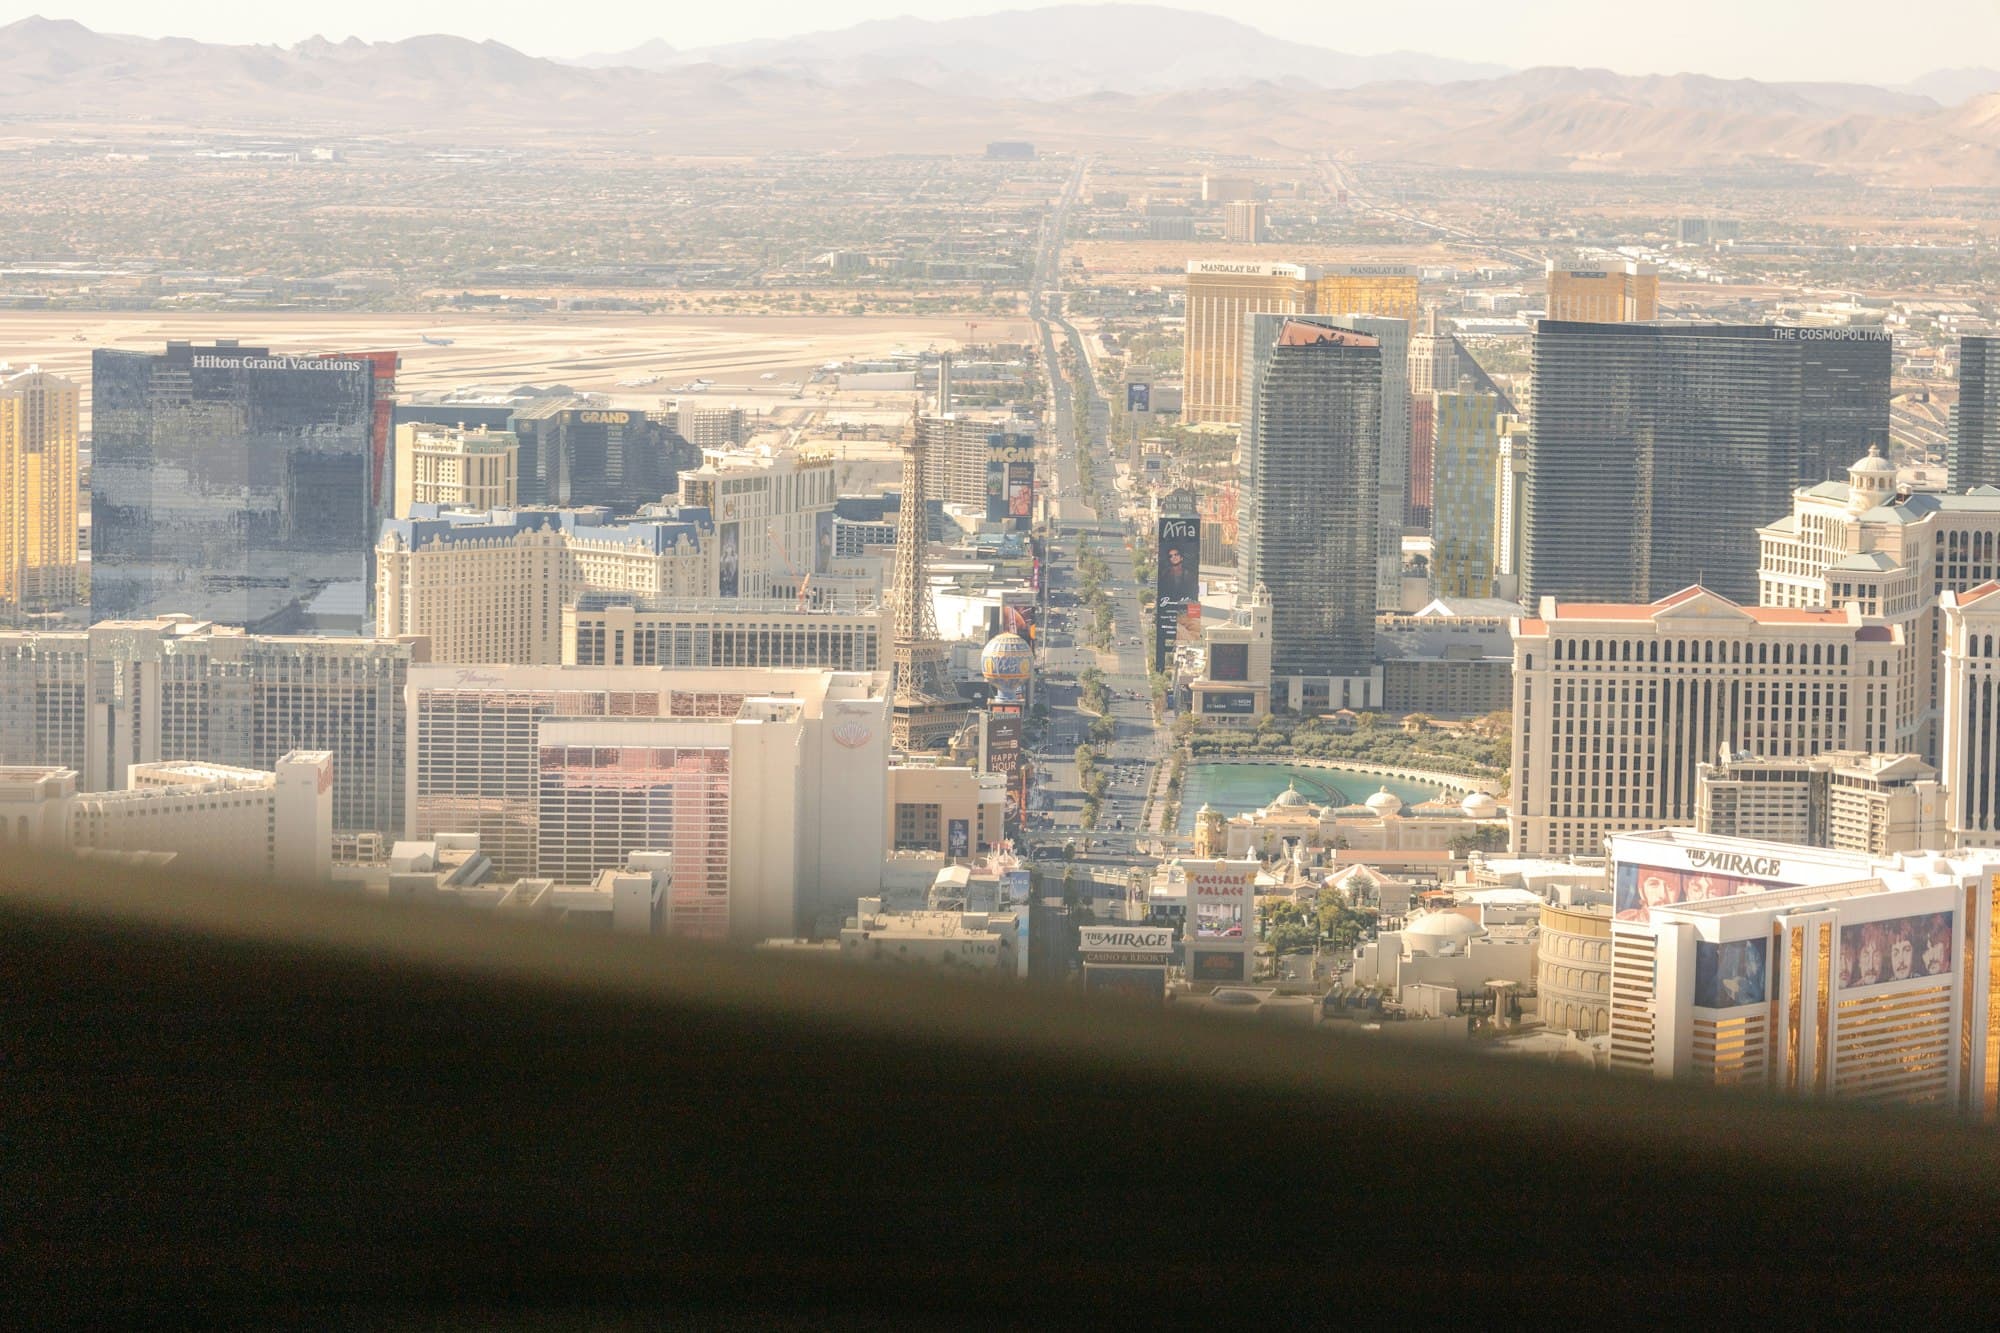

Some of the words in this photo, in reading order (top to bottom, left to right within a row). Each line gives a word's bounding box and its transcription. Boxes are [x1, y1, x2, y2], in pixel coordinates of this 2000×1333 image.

[1200, 263, 1245, 273] MANDALAY
[1246, 264, 1262, 273] BAY
[1561, 262, 1601, 270] DELANO
[1772, 328, 1796, 340] THE
[1800, 328, 1891, 341] COSMOPOLITAN
[193, 355, 240, 369] Hilton
[243, 356, 287, 370] Grand
[290, 357, 360, 371] Vacations
[580, 411, 629, 424] GRAND
[986, 446, 1034, 463] MGM
[1166, 495, 1177, 503] NEW
[1179, 495, 1193, 503] YORK
[1163, 521, 1196, 539] Aria
[991, 753, 1018, 763] HAPPY
[992, 761, 1017, 772] HOUR
[1685, 848, 1707, 860] THE
[1692, 851, 1781, 877] MIRAGE
[1196, 875, 1247, 885] CAESARS
[1197, 886, 1244, 896] PALACE
[1085, 932, 1103, 941] THE
[1090, 932, 1169, 948] MIRAGE
[962, 944, 997, 954] LINQ
[1087, 952, 1120, 961] CASINO
[1130, 952, 1165, 962] RESORT
